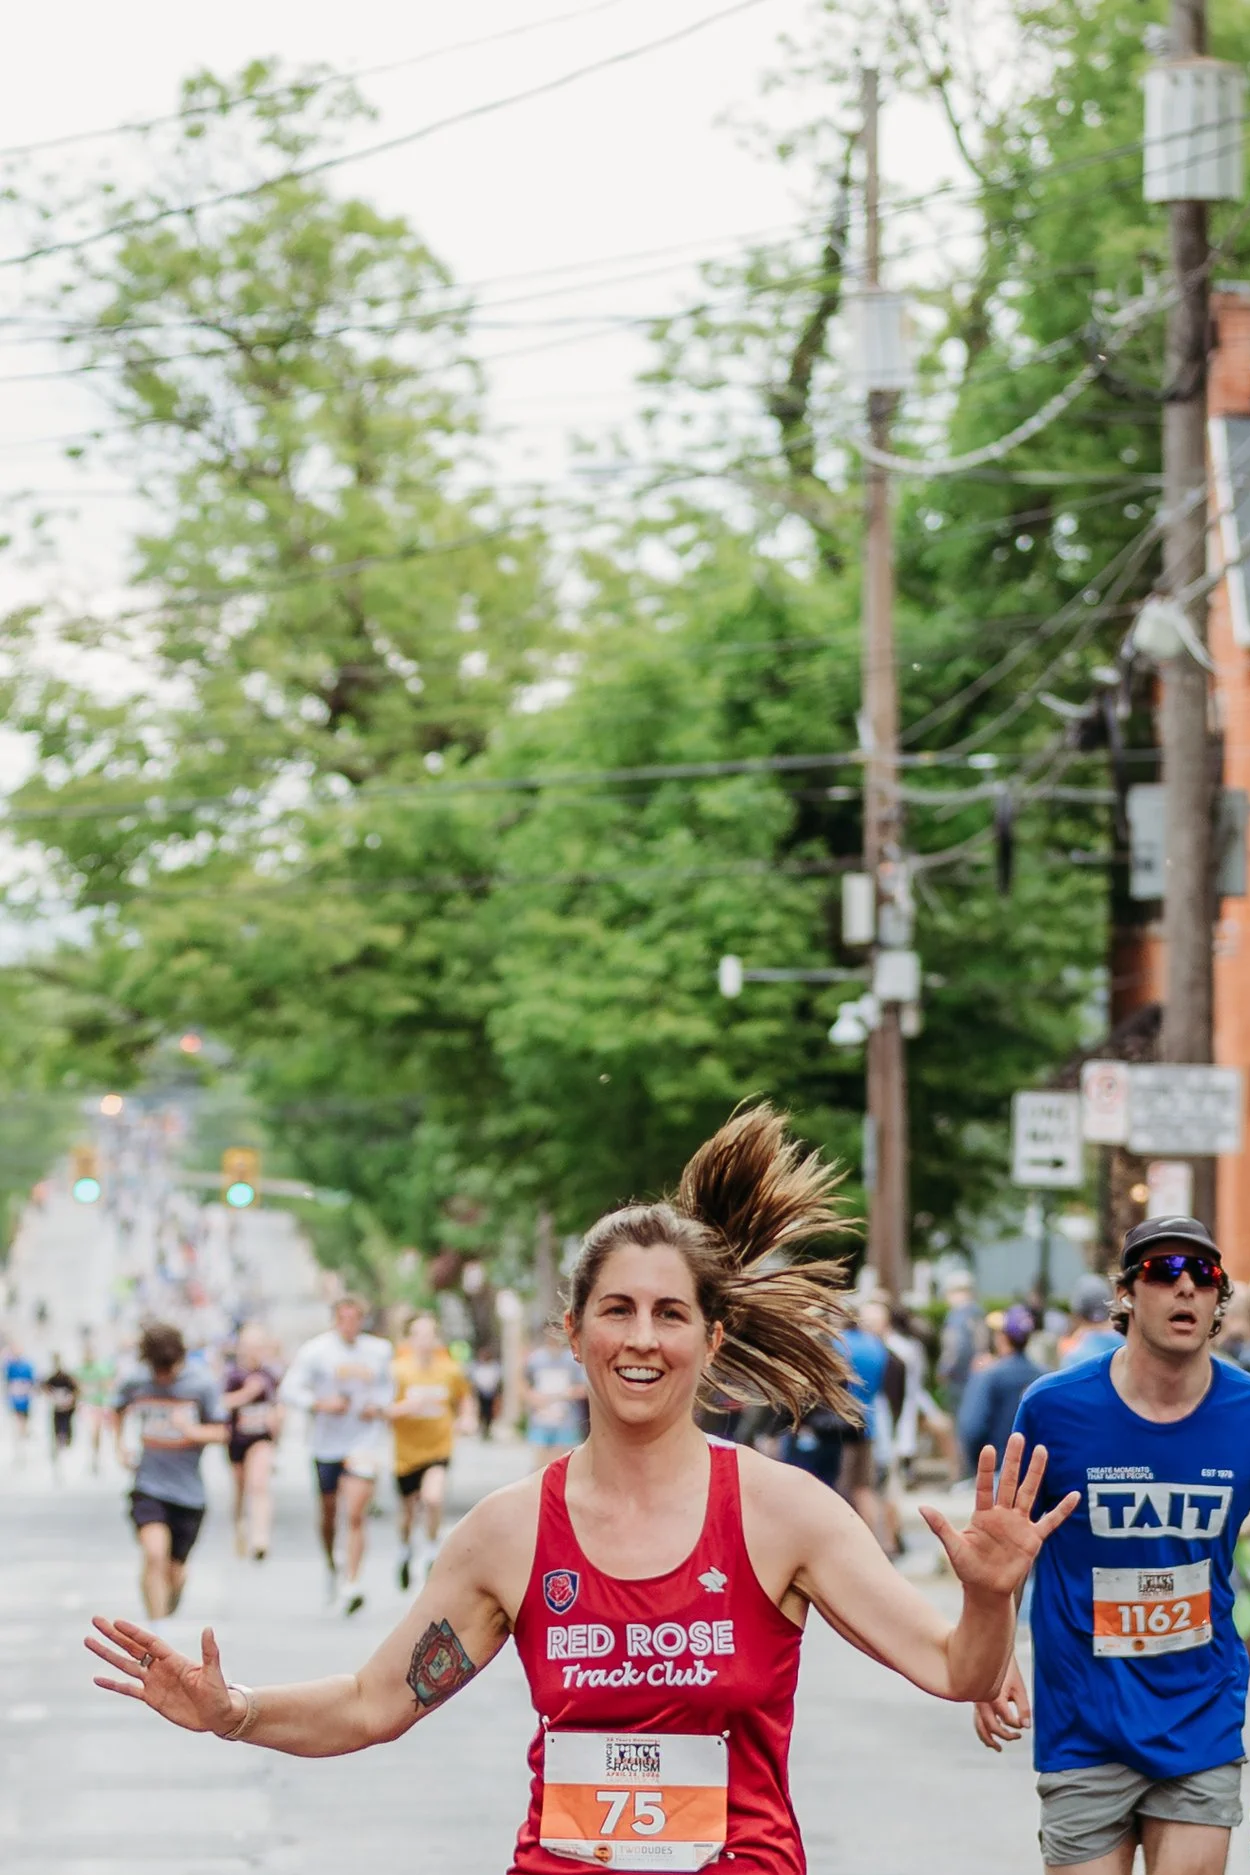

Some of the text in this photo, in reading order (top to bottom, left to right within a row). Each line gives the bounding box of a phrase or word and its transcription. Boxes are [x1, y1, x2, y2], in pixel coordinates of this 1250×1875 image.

[1201, 1468, 1216, 1477] EST
[1096, 1491, 1223, 1531] TAIT
[1118, 1600, 1191, 1633] 1162
[547, 1620, 735, 1660] RED ROSE
[562, 1659, 718, 1688] Track Club
[613, 1763, 660, 1772] RACISM
[595, 1790, 667, 1836] 75
